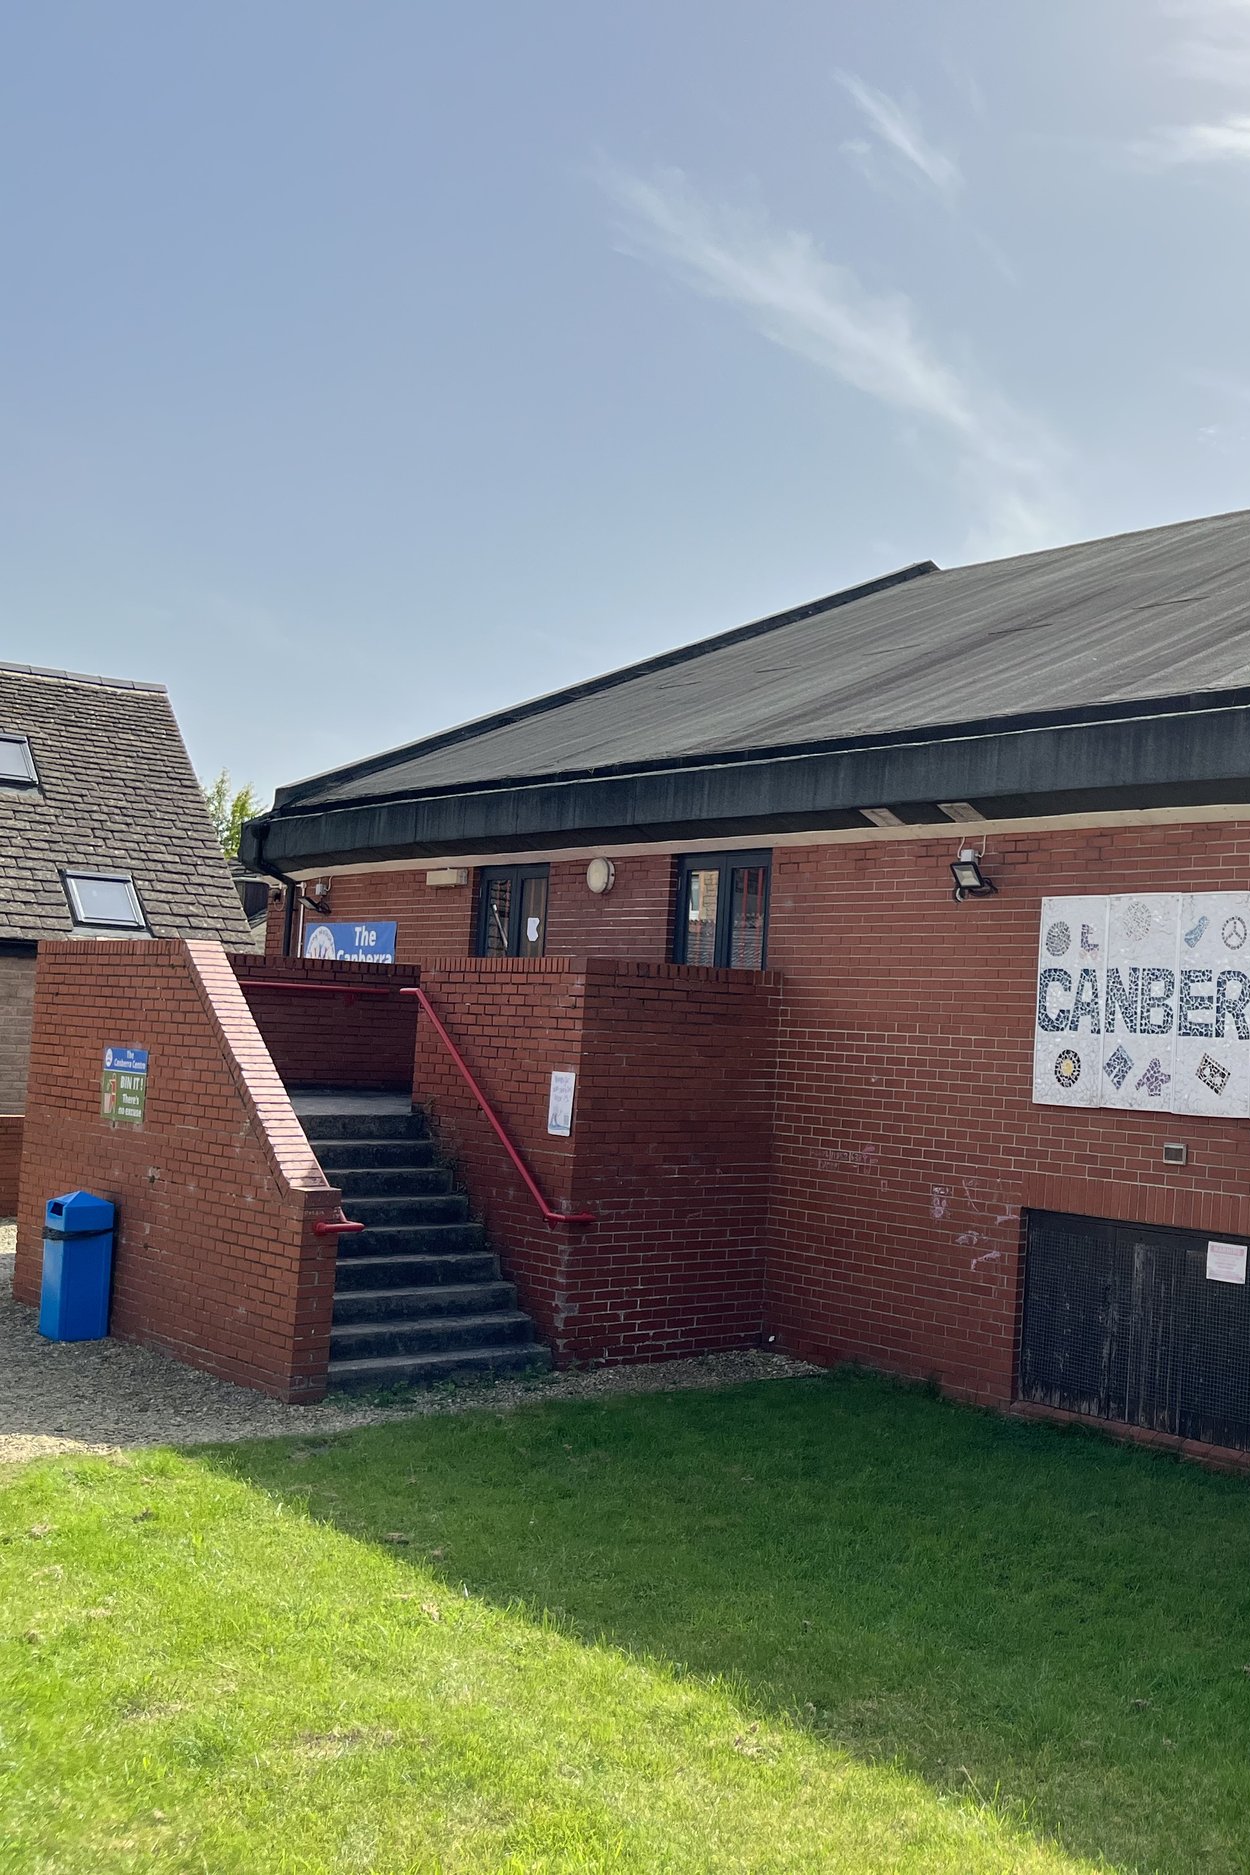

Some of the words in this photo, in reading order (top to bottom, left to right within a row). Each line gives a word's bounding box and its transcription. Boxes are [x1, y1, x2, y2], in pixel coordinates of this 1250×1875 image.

[354, 925, 377, 947] The
[122, 1094, 139, 1105] There's
[125, 1108, 142, 1118] excuse
